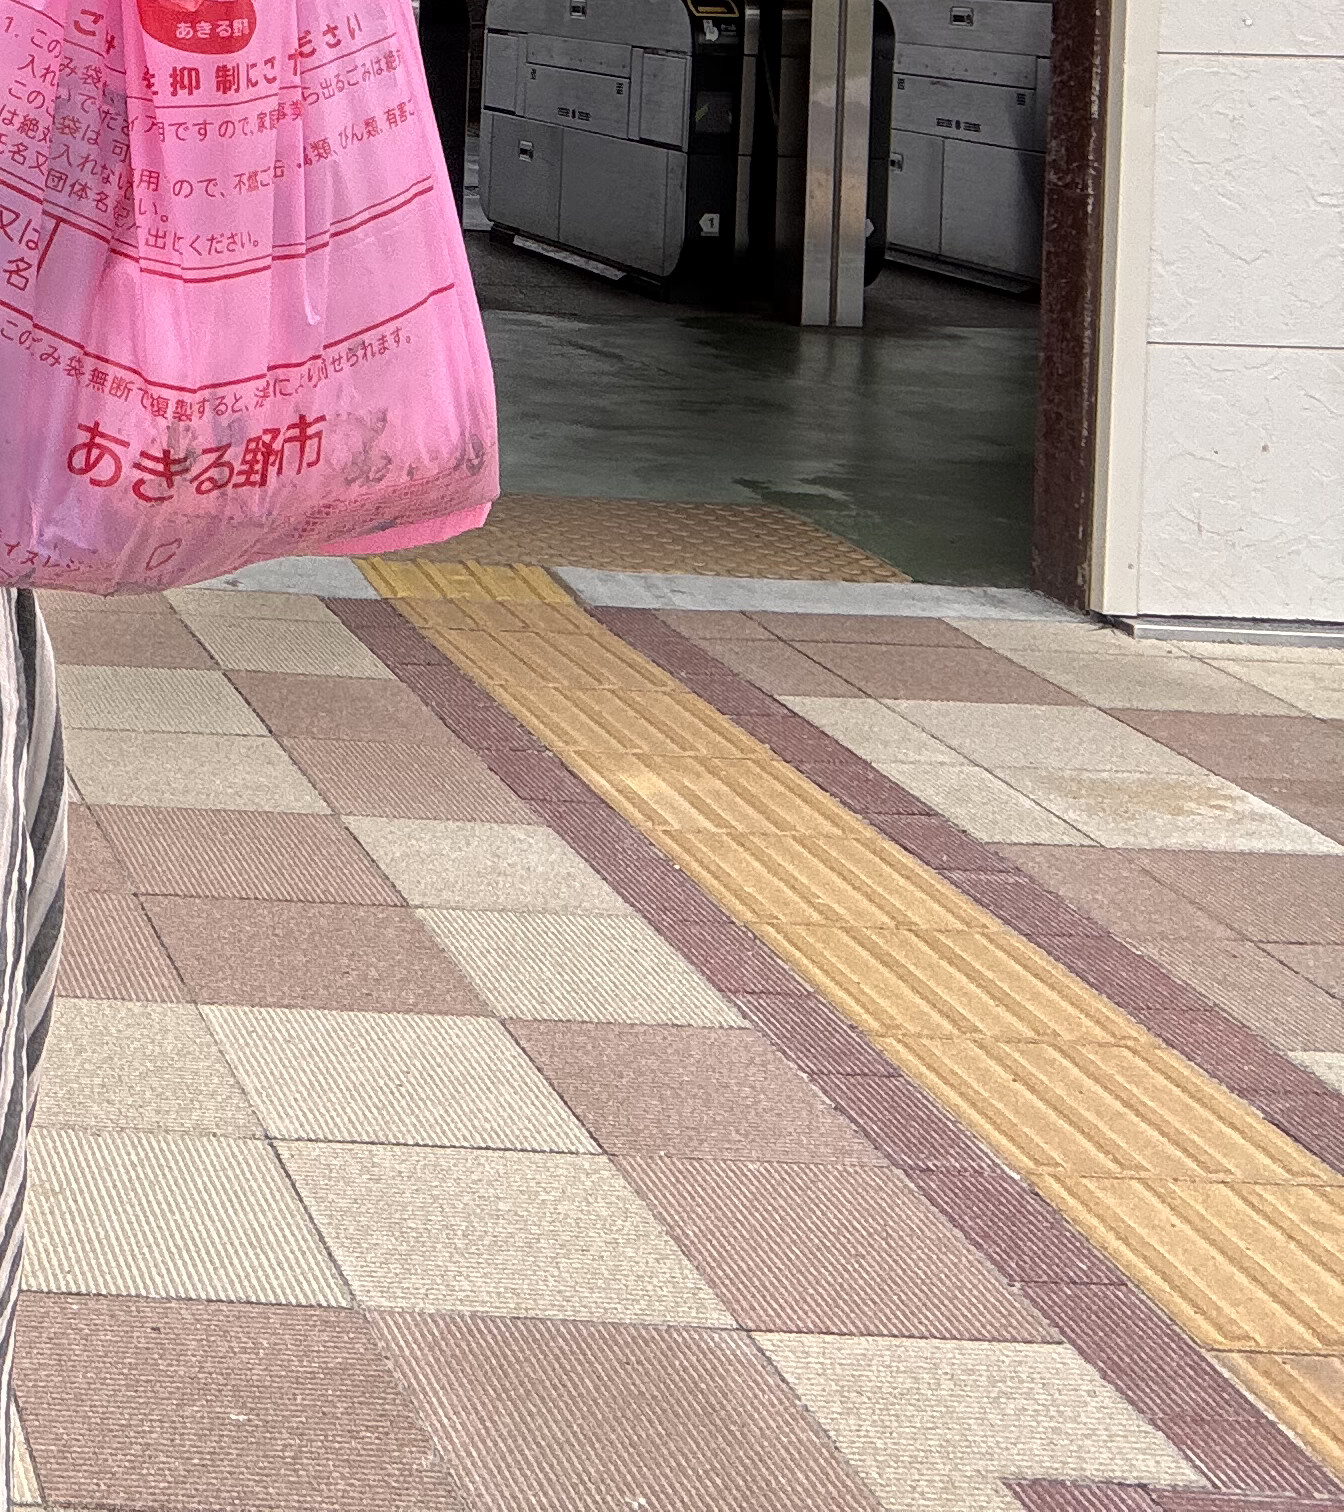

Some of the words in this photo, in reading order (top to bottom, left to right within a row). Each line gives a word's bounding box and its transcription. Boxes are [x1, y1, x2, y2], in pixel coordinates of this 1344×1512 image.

[65, 411, 332, 506] あきる野市
